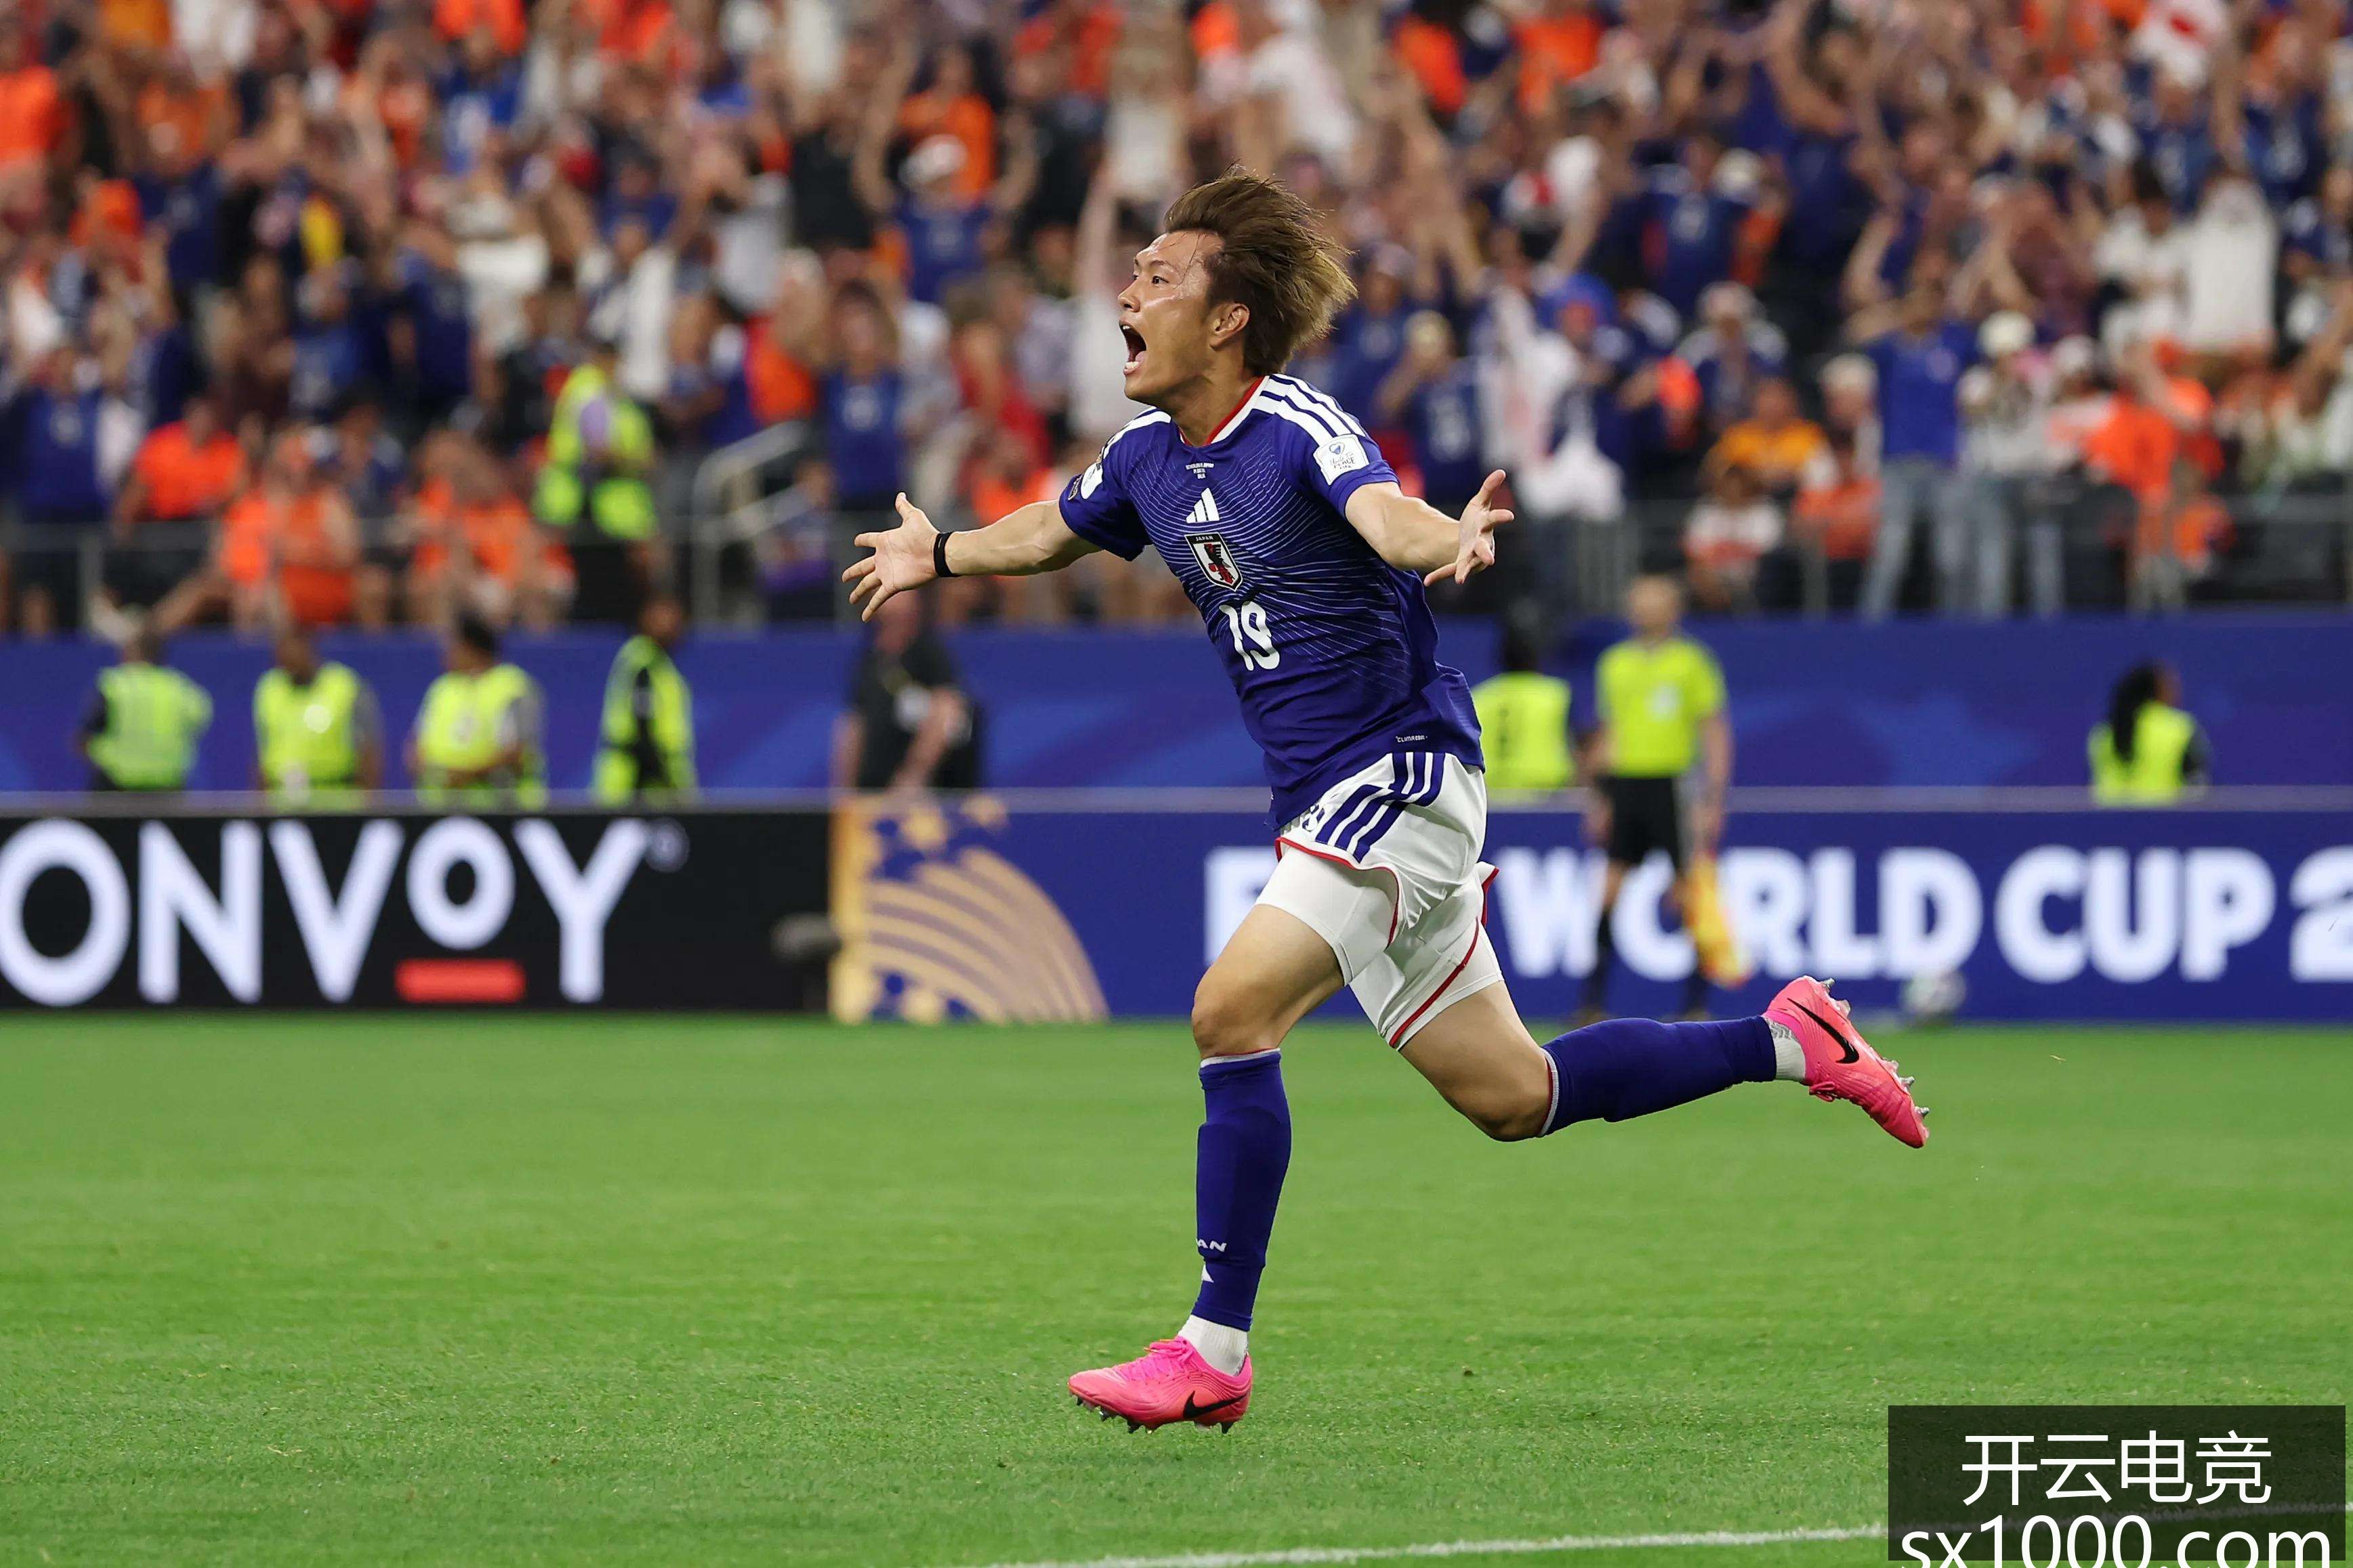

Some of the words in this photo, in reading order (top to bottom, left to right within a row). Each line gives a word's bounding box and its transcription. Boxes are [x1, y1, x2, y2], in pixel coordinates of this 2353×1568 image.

[1220, 600, 1280, 671] 19
[0, 817, 648, 1006] ONVOY
[1995, 845, 2275, 982] CUP
